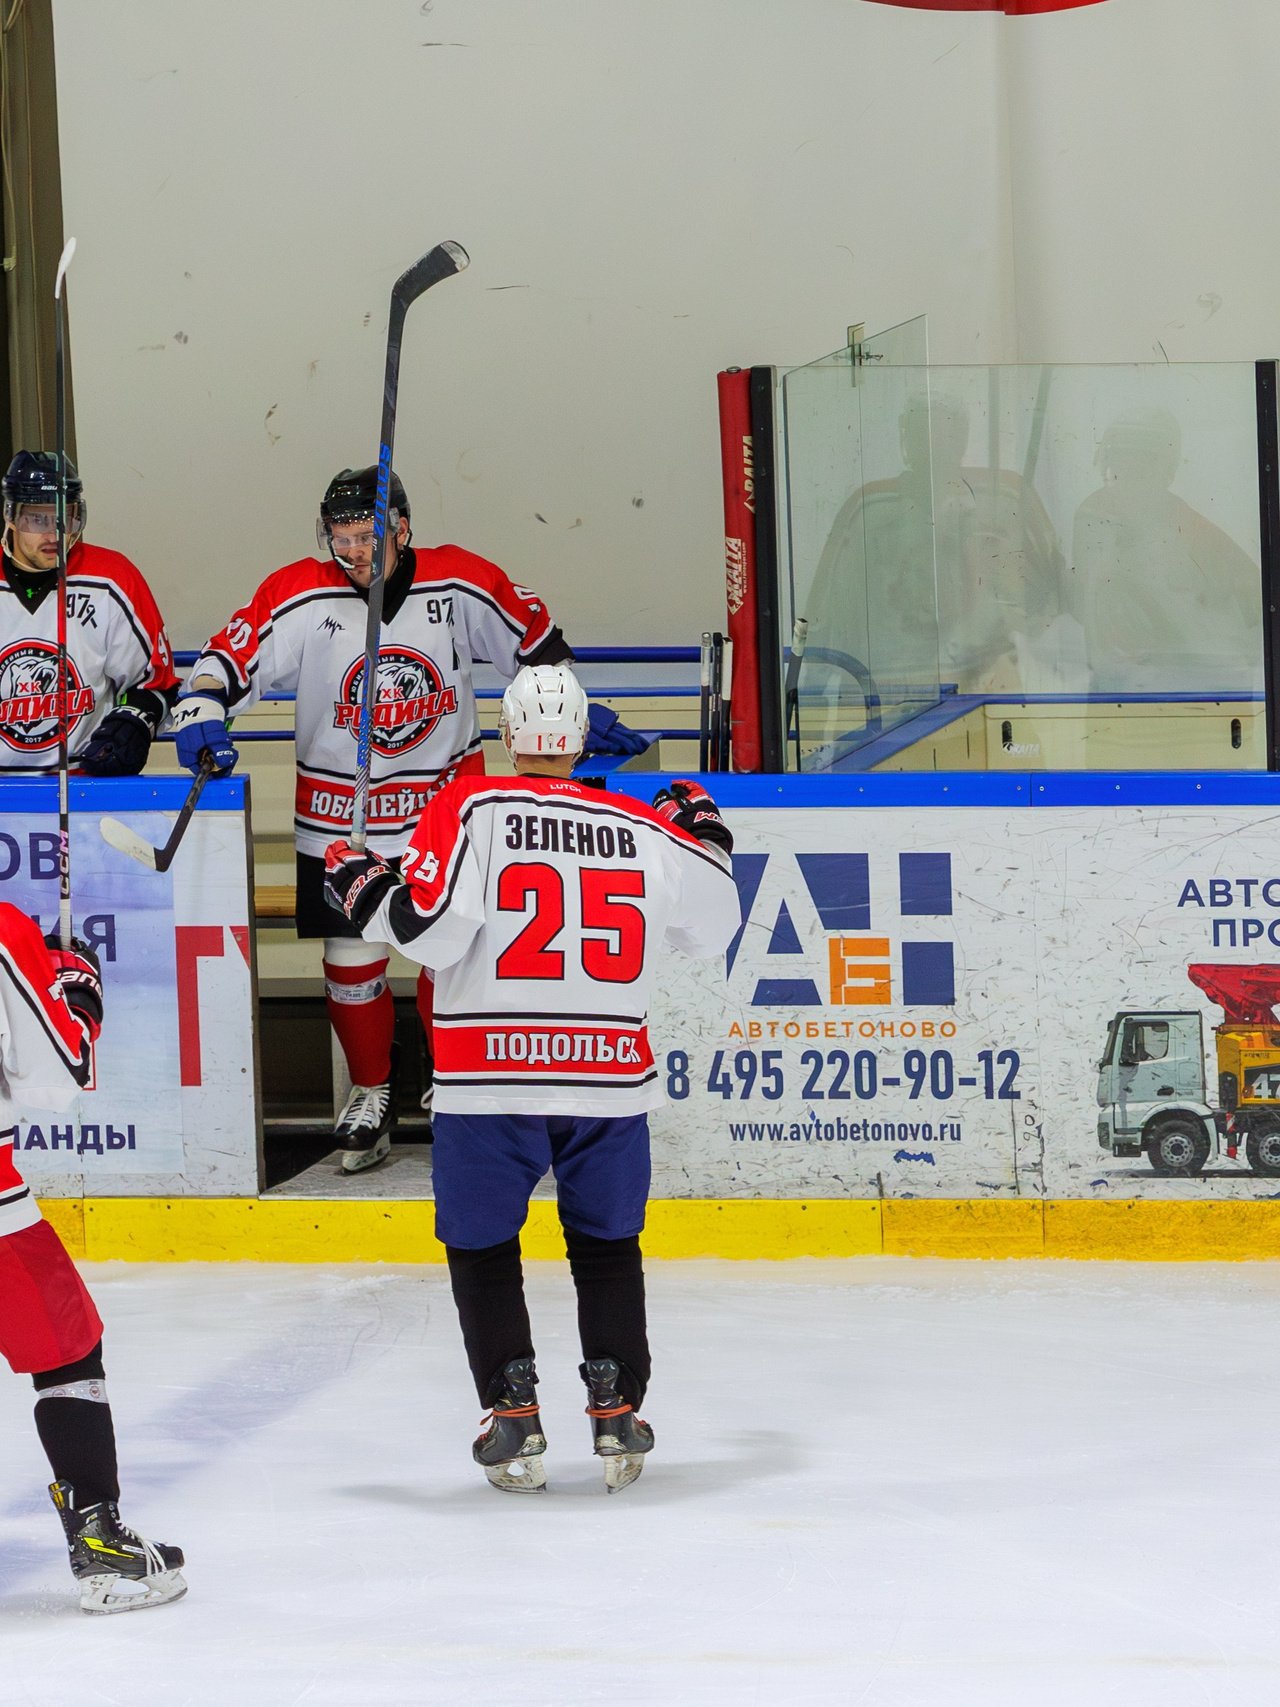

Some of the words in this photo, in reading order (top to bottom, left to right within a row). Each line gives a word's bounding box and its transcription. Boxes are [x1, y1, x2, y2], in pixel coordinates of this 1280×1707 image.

[19, 681, 41, 693] ХК
[381, 687, 404, 699] ХК
[549, 783, 582, 793] LUTCH
[505, 813, 638, 859] ЗЕЛЕНОВ
[496, 862, 646, 984] 25
[728, 1021, 957, 1039] АВТОБЕТОНОВО
[485, 1031, 642, 1065] ПОДОЛЬСК
[666, 1049, 690, 1101] 8
[708, 1049, 783, 1101] 495
[801, 1049, 1022, 1101] 220-90-12
[729, 1117, 962, 1143] www.avtobetonovo.ru
